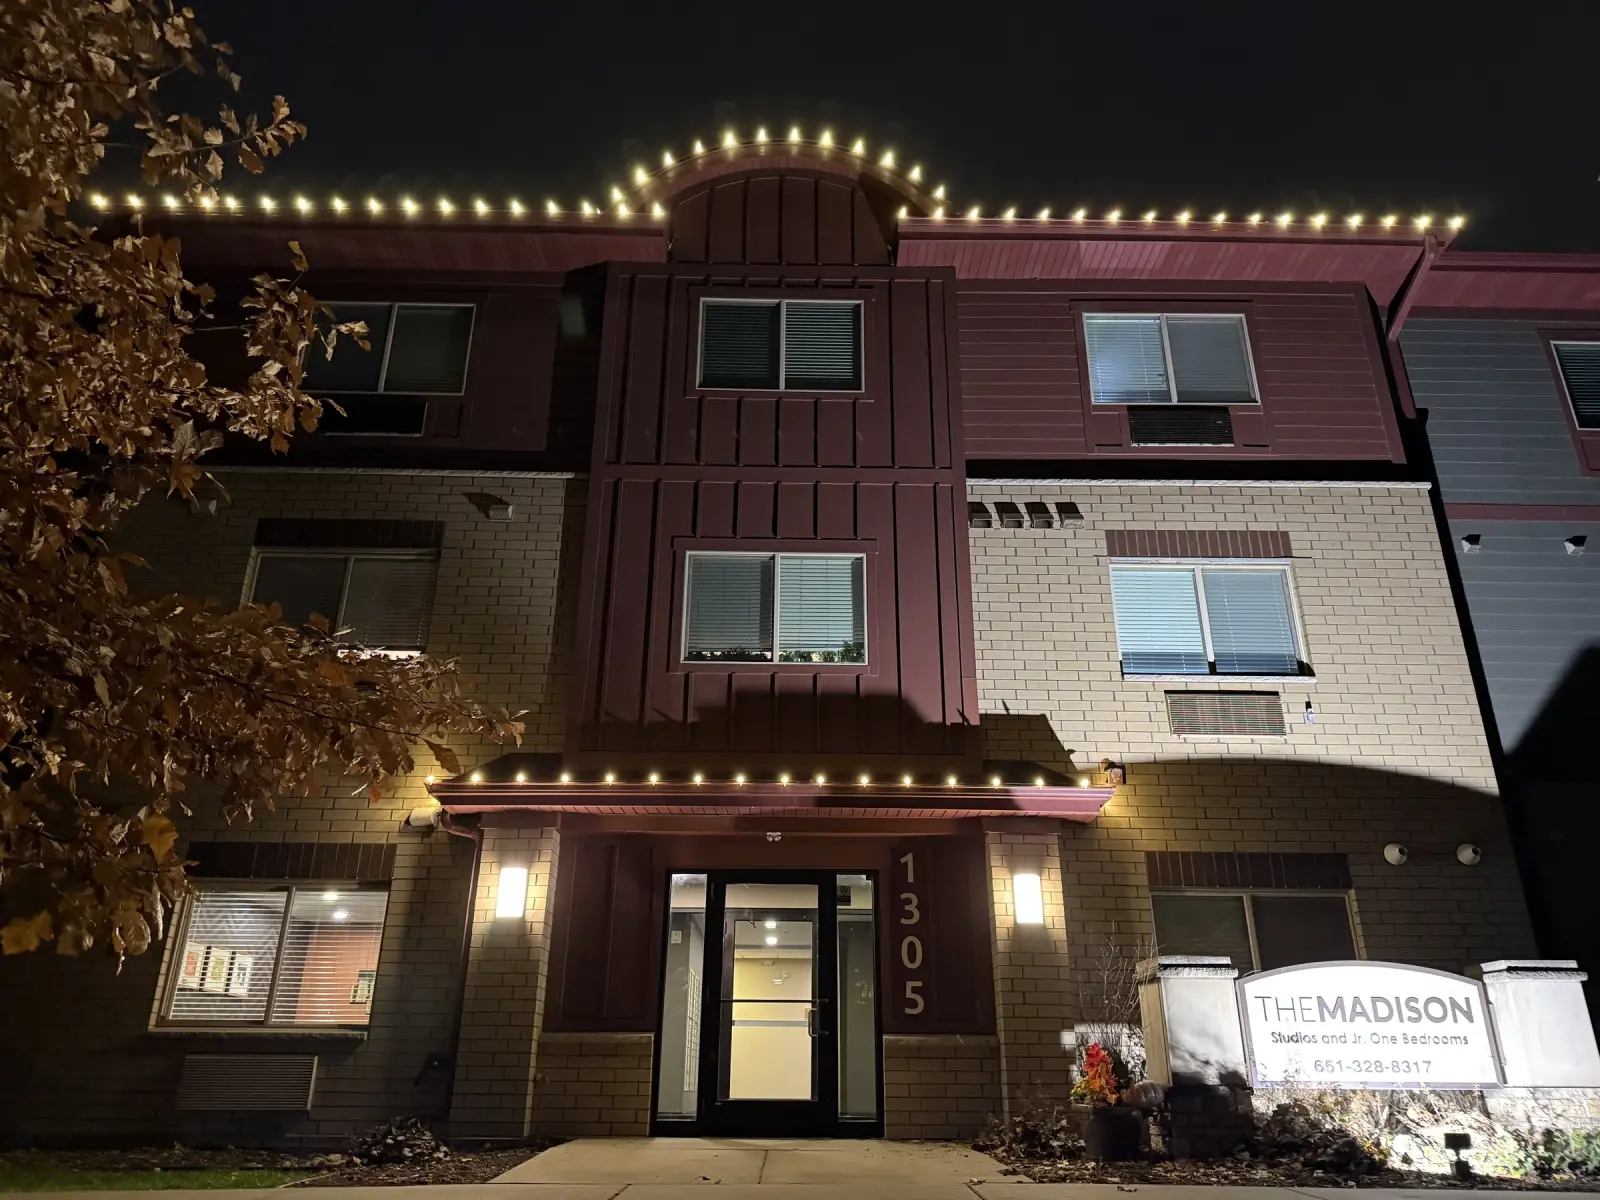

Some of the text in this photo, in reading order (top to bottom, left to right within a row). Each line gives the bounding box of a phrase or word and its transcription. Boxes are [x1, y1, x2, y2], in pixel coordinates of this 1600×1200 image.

[899, 852, 925, 1015] 1305
[1271, 1031, 1469, 1046] Studios and Jr. One Bedrooms
[1313, 1059, 1433, 1074] 651-328-8317
